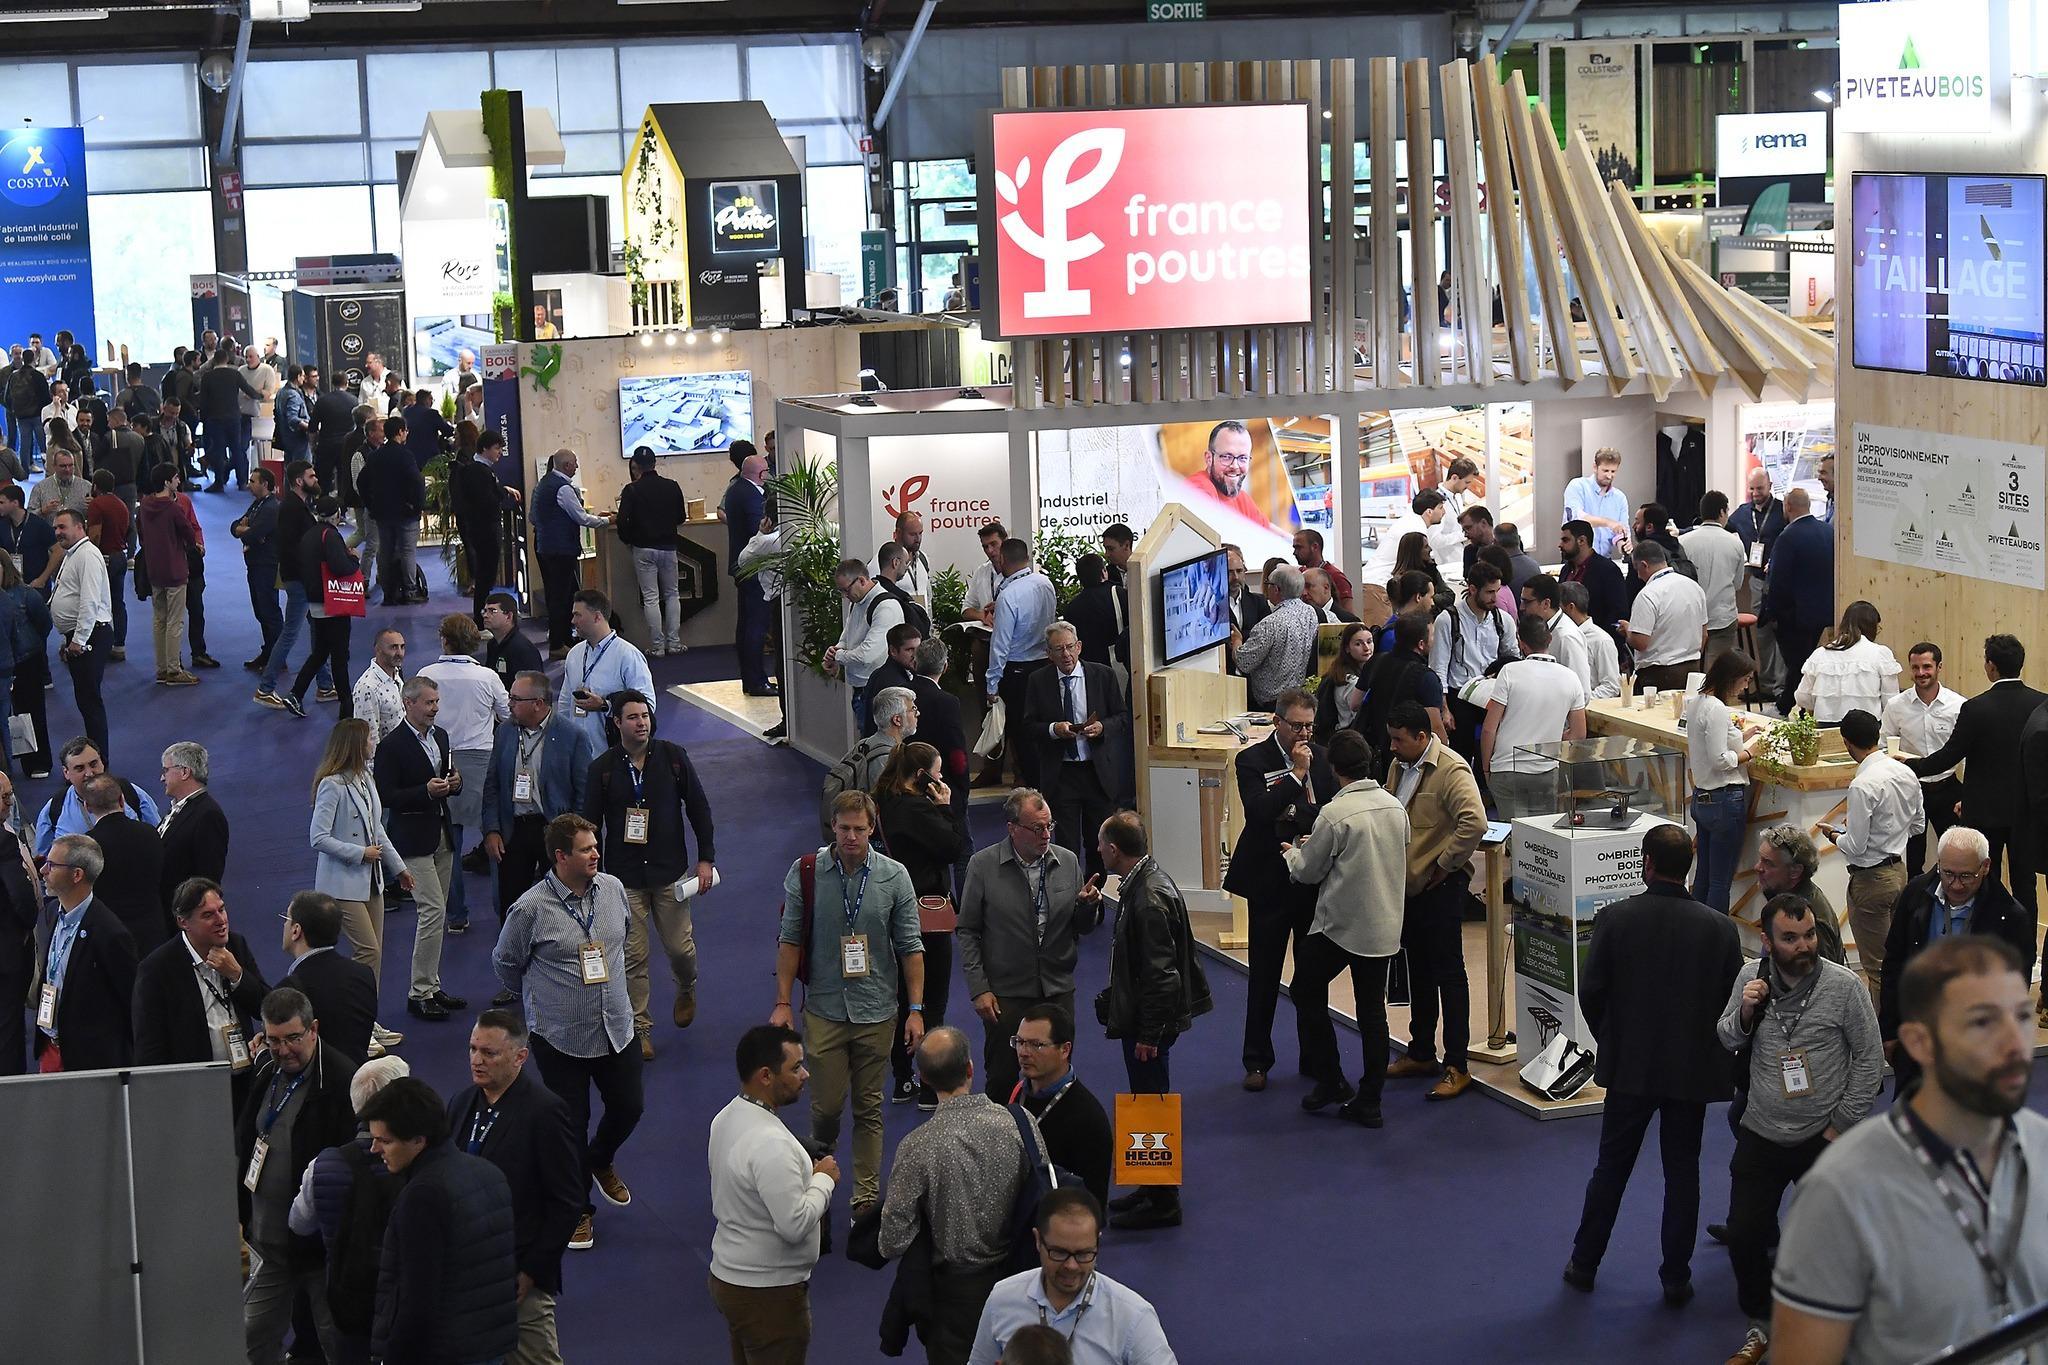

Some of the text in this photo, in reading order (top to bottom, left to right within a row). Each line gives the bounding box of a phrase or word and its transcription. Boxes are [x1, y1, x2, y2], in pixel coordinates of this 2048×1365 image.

[1151, 3, 1203, 19] SORTIE
[1847, 75, 1984, 99] PIVETEAUBOIS
[1755, 133, 1807, 149] rema
[7, 176, 70, 190] COSYLVA
[1124, 193, 1283, 237] france
[39, 222, 78, 232] industriel
[4, 232, 71, 244] de lamellé collé
[1126, 242, 1310, 296] poutres
[1868, 253, 2028, 300] TAILLAGE
[4, 273, 76, 285] www.cosylva.com
[192, 282, 215, 290] BOIS
[869, 283, 877, 308] TORA
[485, 356, 516, 367] BOIS
[500, 414, 507, 425] SA
[1858, 432, 1870, 442] UN
[1858, 444, 1949, 465] APPROVISIONNEMENT
[1858, 456, 1883, 467] LOCAL
[2008, 471, 2019, 492] 3
[930, 497, 990, 513] france
[1039, 492, 1108, 509] Industriel
[1998, 491, 2030, 508] SITES
[2004, 505, 2030, 513] PRODUCTION
[931, 513, 1000, 532] poutres
[1040, 512, 1129, 528] de solutions
[1988, 534, 2040, 551] PIVETEAUBOIS
[1524, 841, 1559, 860] OMBRIÈRES
[1534, 855, 1549, 868] BOIS
[1617, 859, 1643, 871] BOIS
[1518, 860, 1566, 884] PHOTOVOLTAÏQUES
[1125, 1151, 1172, 1160] HECO
